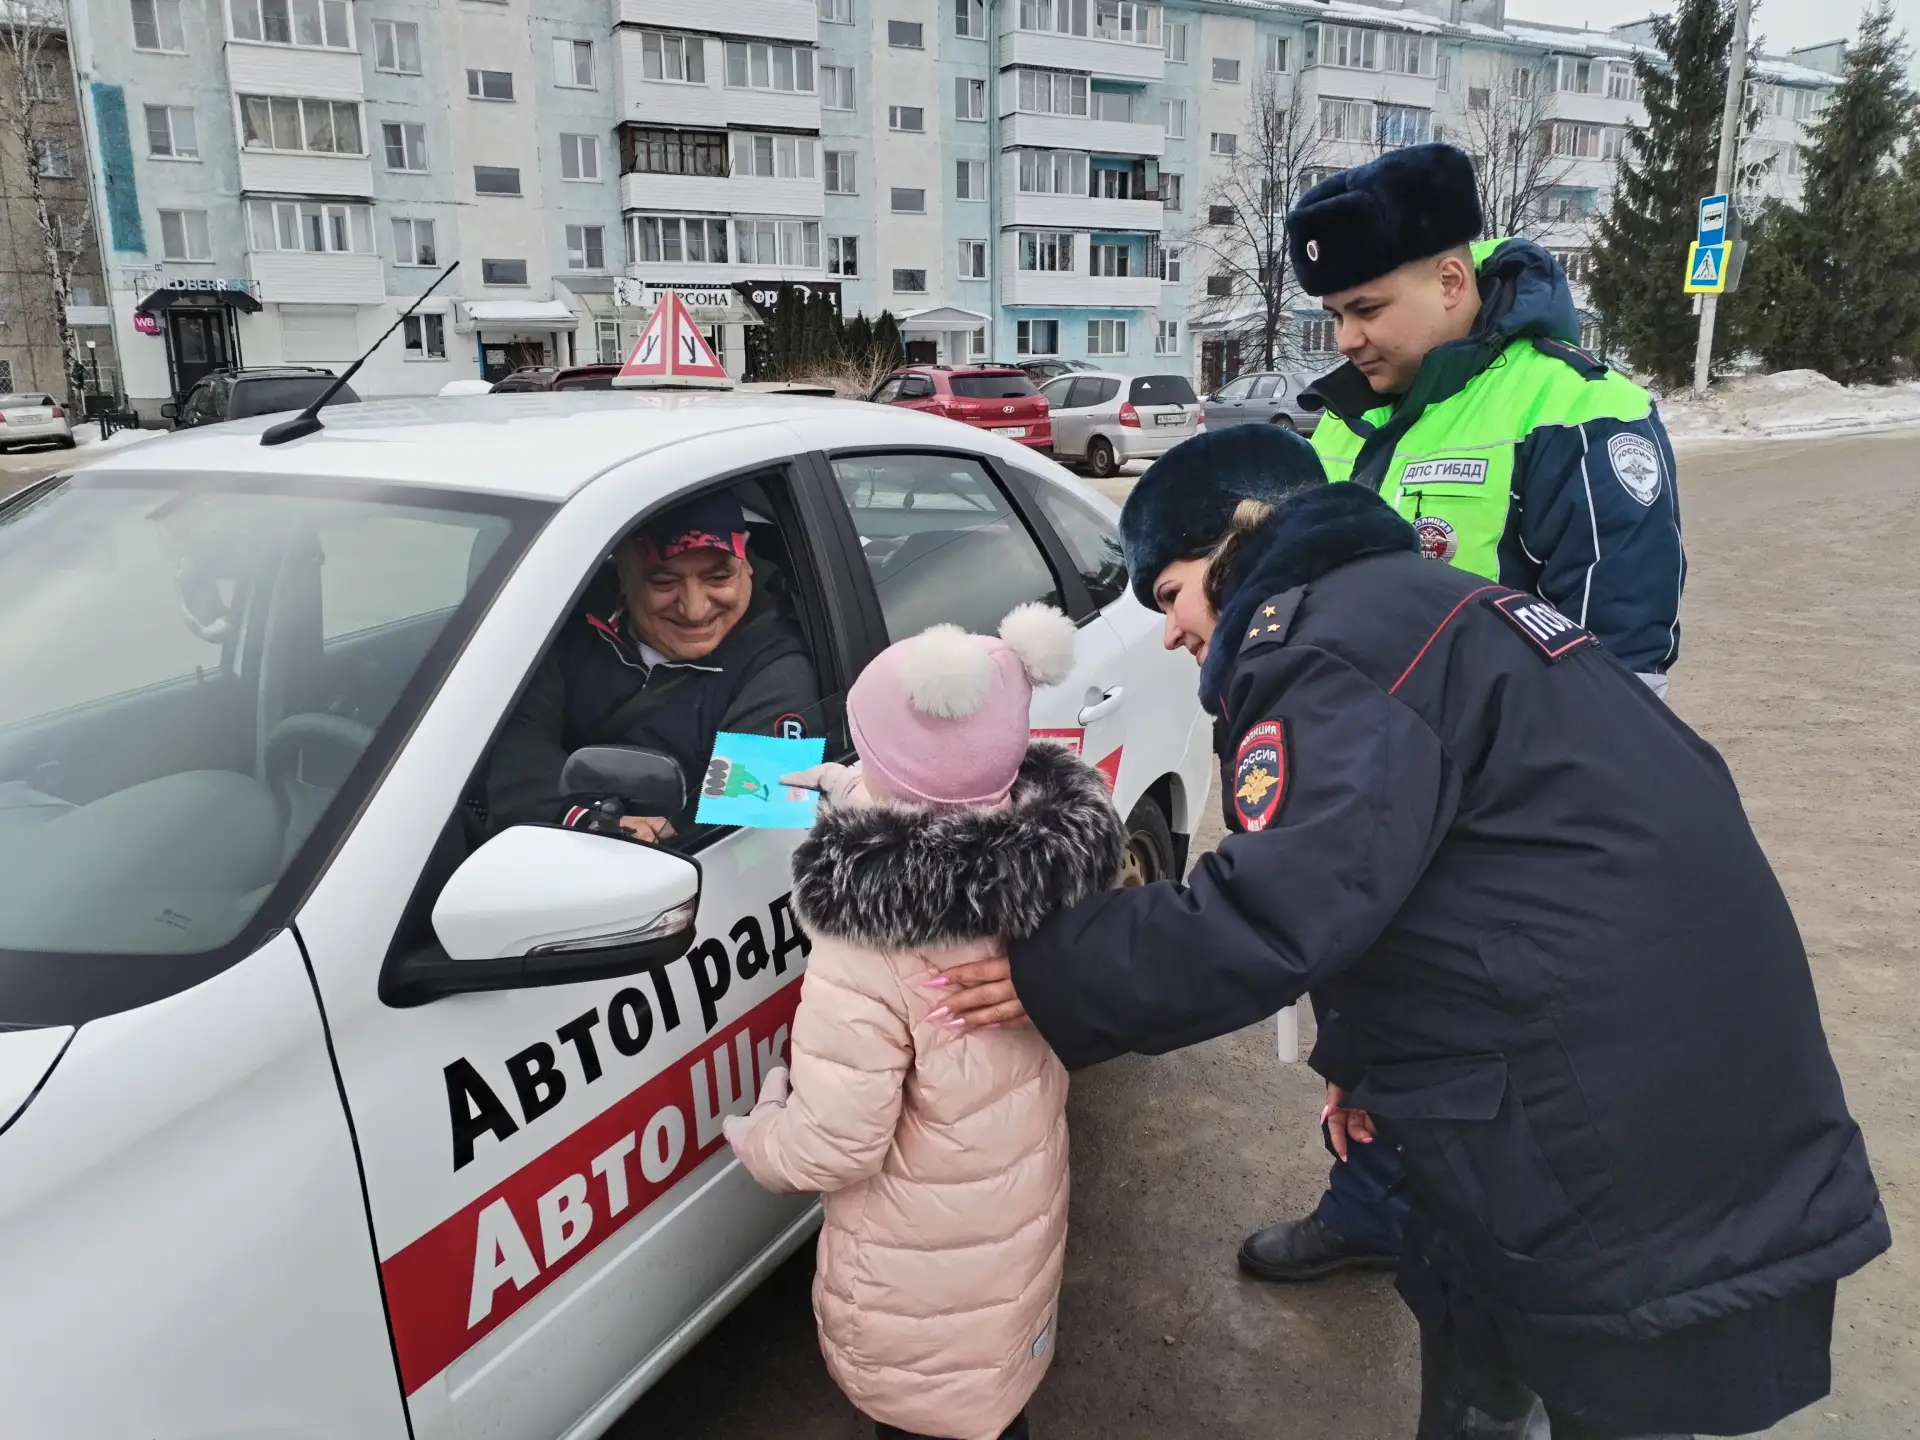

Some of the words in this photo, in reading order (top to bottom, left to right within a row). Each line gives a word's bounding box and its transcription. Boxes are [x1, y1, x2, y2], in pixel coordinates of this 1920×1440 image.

[653, 291, 728, 306] ПРСОНА
[135, 317, 155, 327] WB
[1612, 436, 1652, 452] ПОЛИЦИЯ
[1617, 448, 1653, 463] РОССИЯ
[1405, 465, 1433, 480] ДПС
[1434, 462, 1482, 479] ГИБДД
[1413, 517, 1453, 533] ОЛИЦИЯ
[1239, 724, 1277, 751] ПОЛИЦИЯ
[1238, 749, 1277, 778] РОССИЯ
[467, 1022, 790, 1330] АвтоШк
